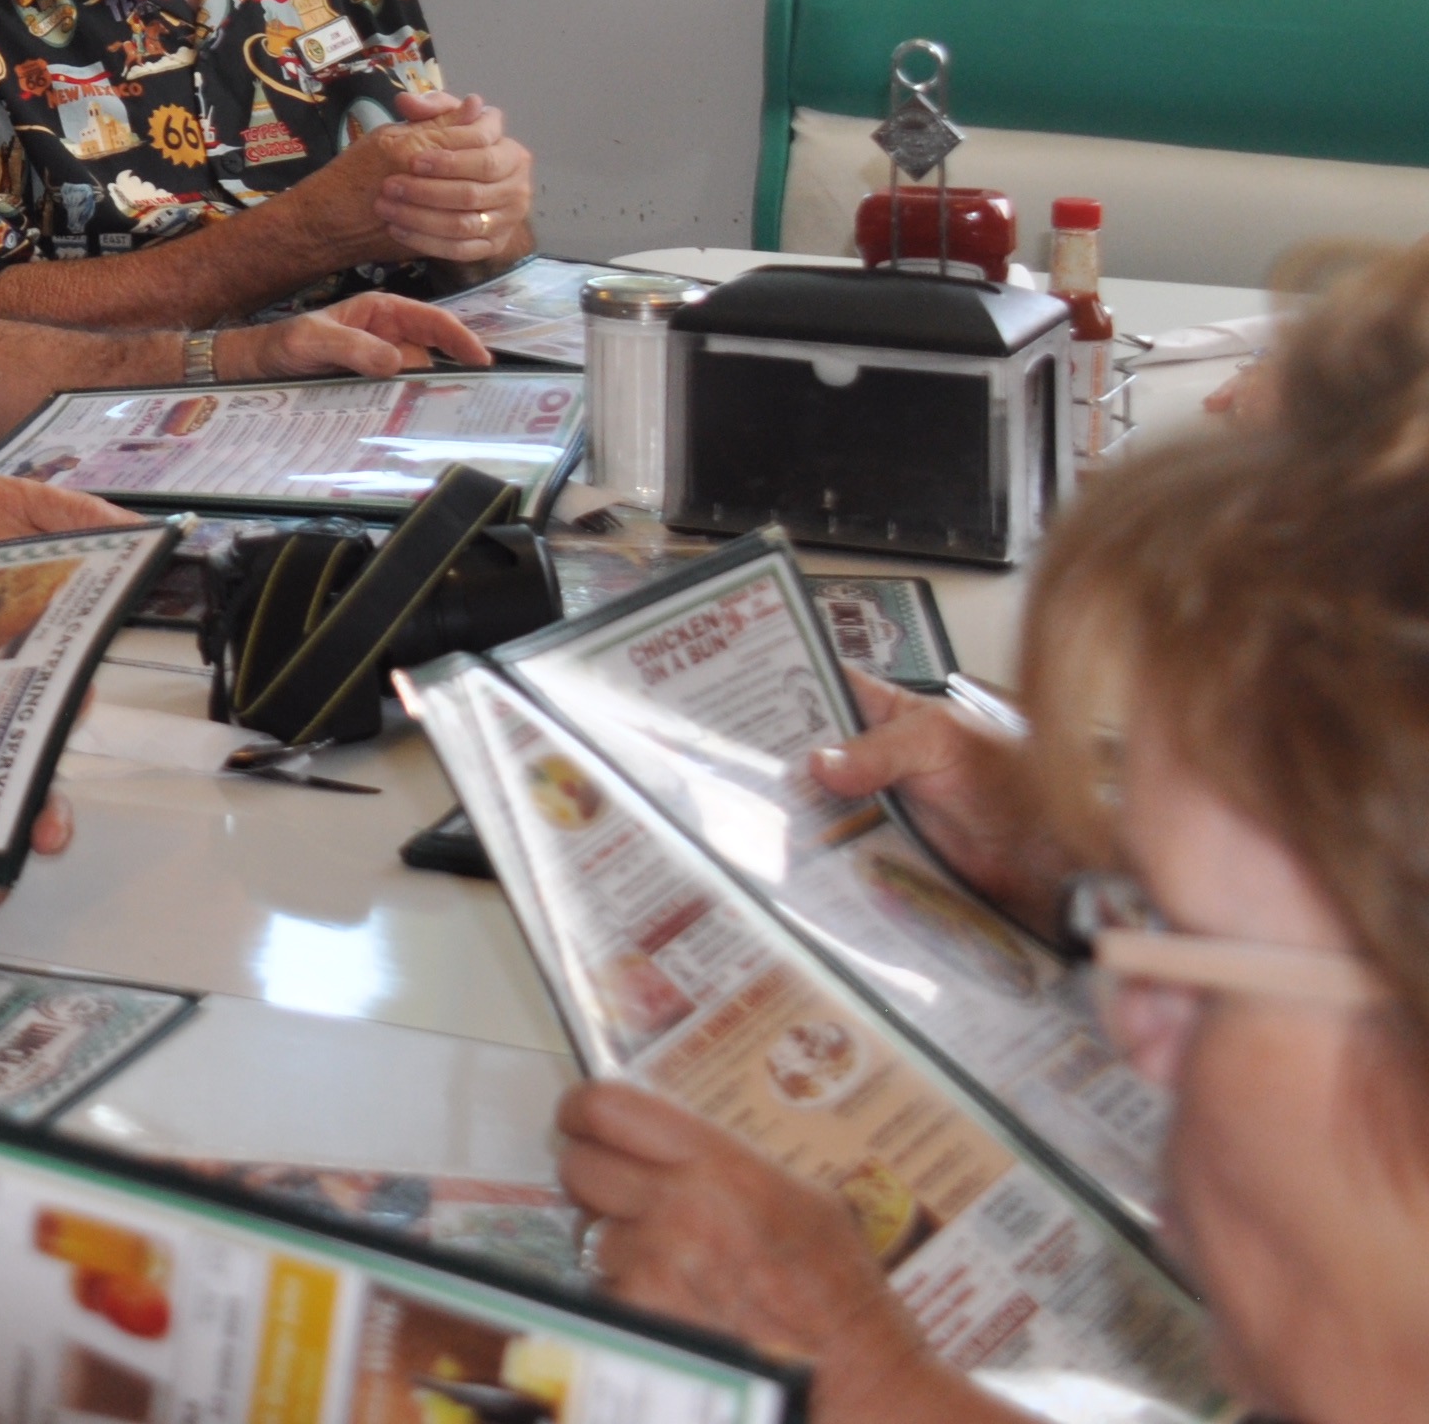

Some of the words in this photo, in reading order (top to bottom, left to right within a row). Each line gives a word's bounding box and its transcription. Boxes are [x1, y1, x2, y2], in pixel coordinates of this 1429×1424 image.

[46, 84, 81, 109] NEW
[82, 82, 144, 99] MEXICO
[162, 114, 200, 151] 66
[240, 121, 292, 144] TEPEE
[245, 137, 308, 164] CURIOS
[627, 608, 721, 668] CHICKEN
[671, 653, 687, 672] A
[687, 635, 729, 665] BUN
[17, 624, 82, 723] CATERING
